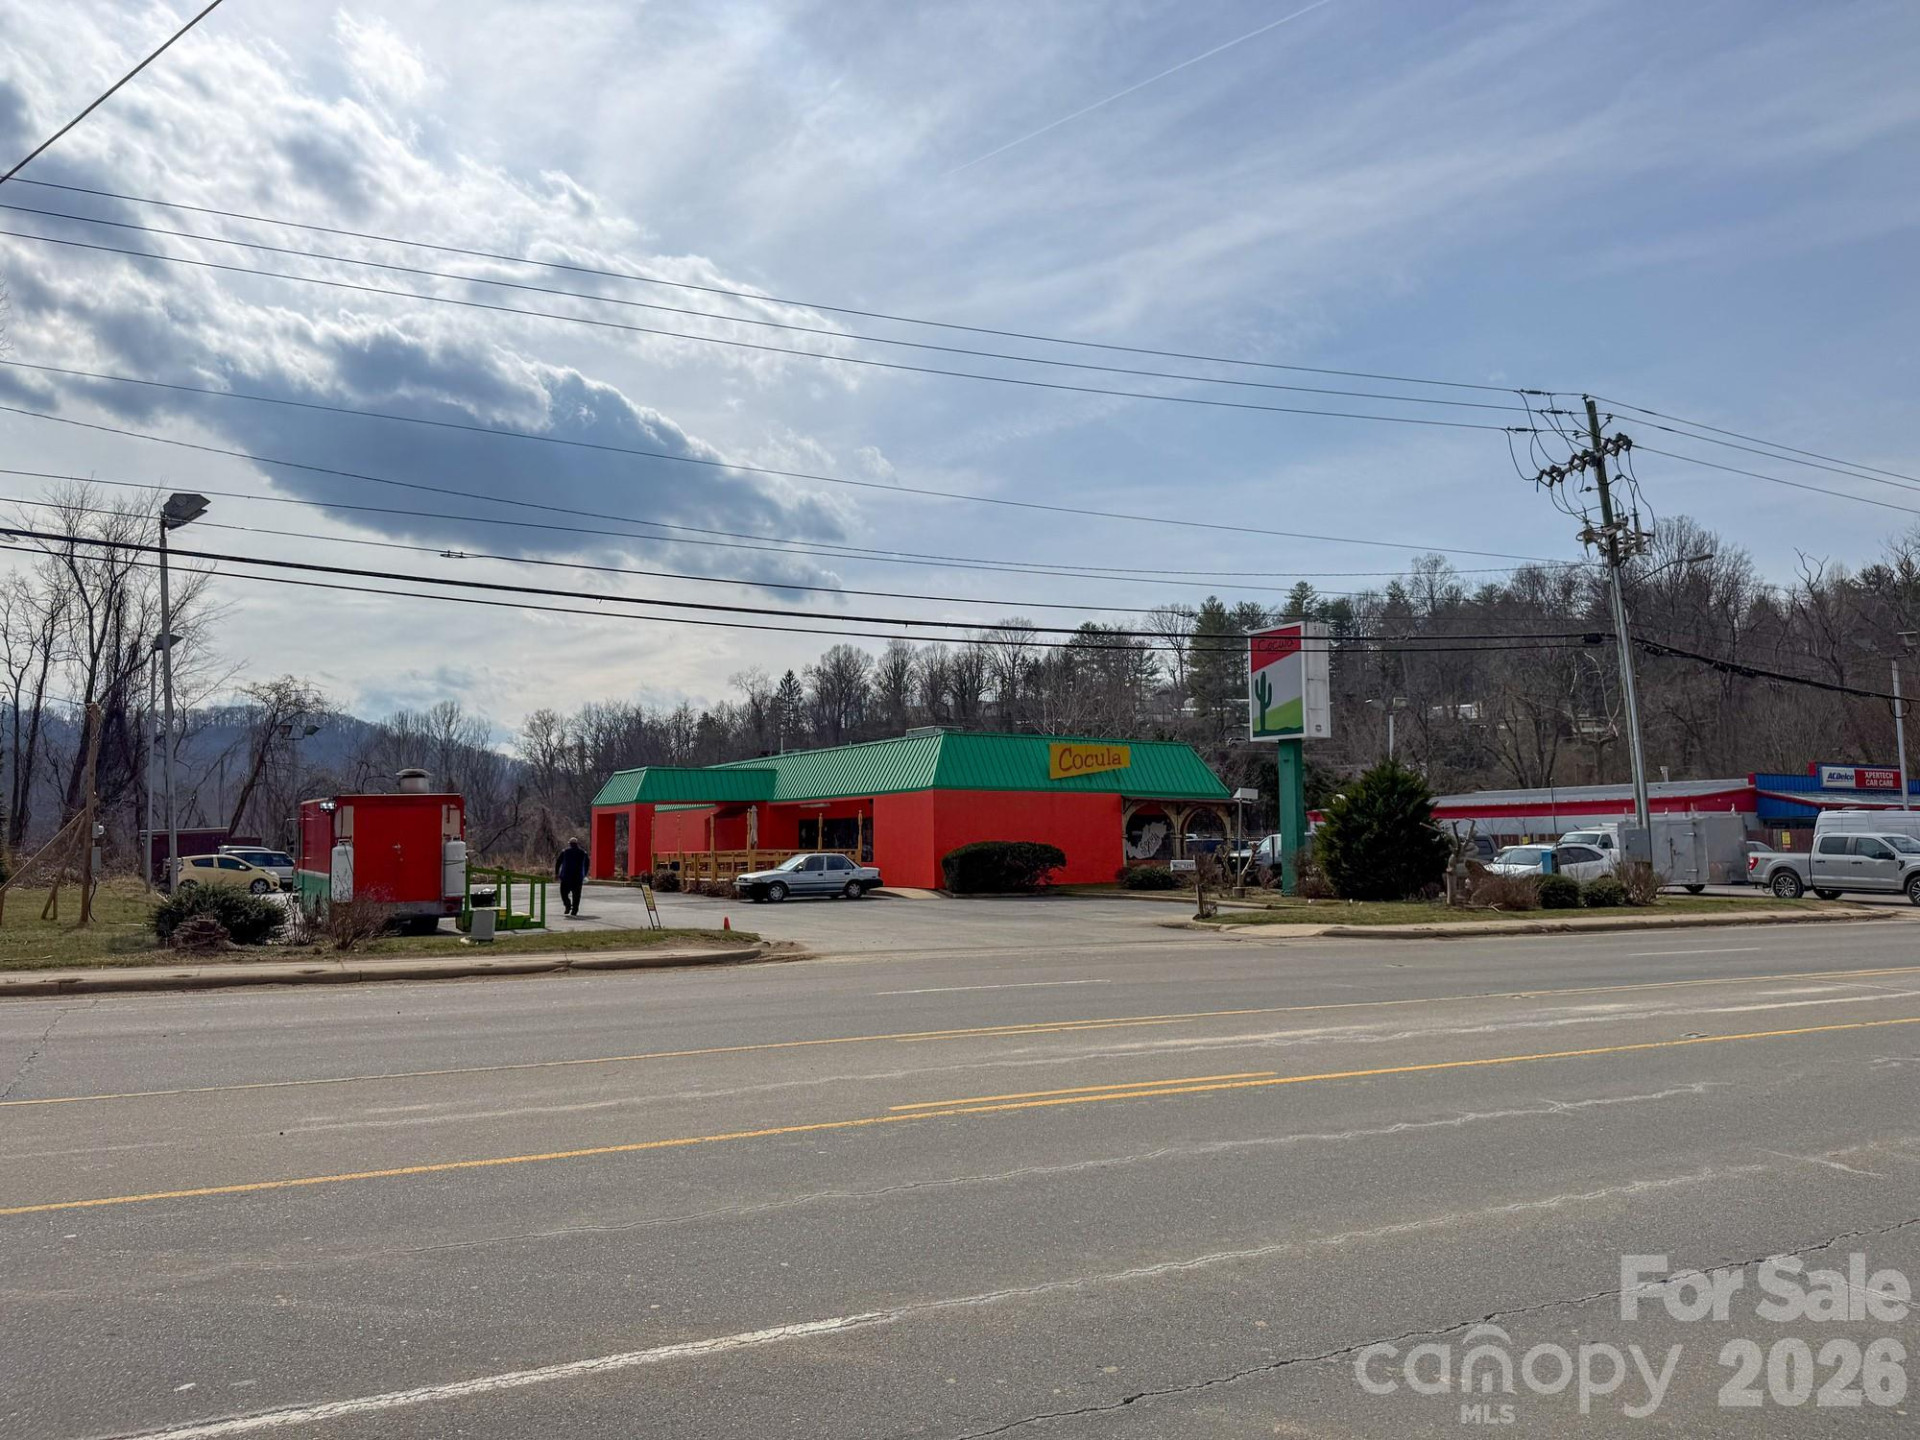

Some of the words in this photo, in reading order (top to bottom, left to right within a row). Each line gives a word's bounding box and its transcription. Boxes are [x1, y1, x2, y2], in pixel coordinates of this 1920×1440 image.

[1058, 748, 1122, 772] Cocula
[1827, 772, 1854, 780] ACDelco
[1864, 771, 1894, 780] XPERTECH
[1865, 779, 1878, 787] CAR
